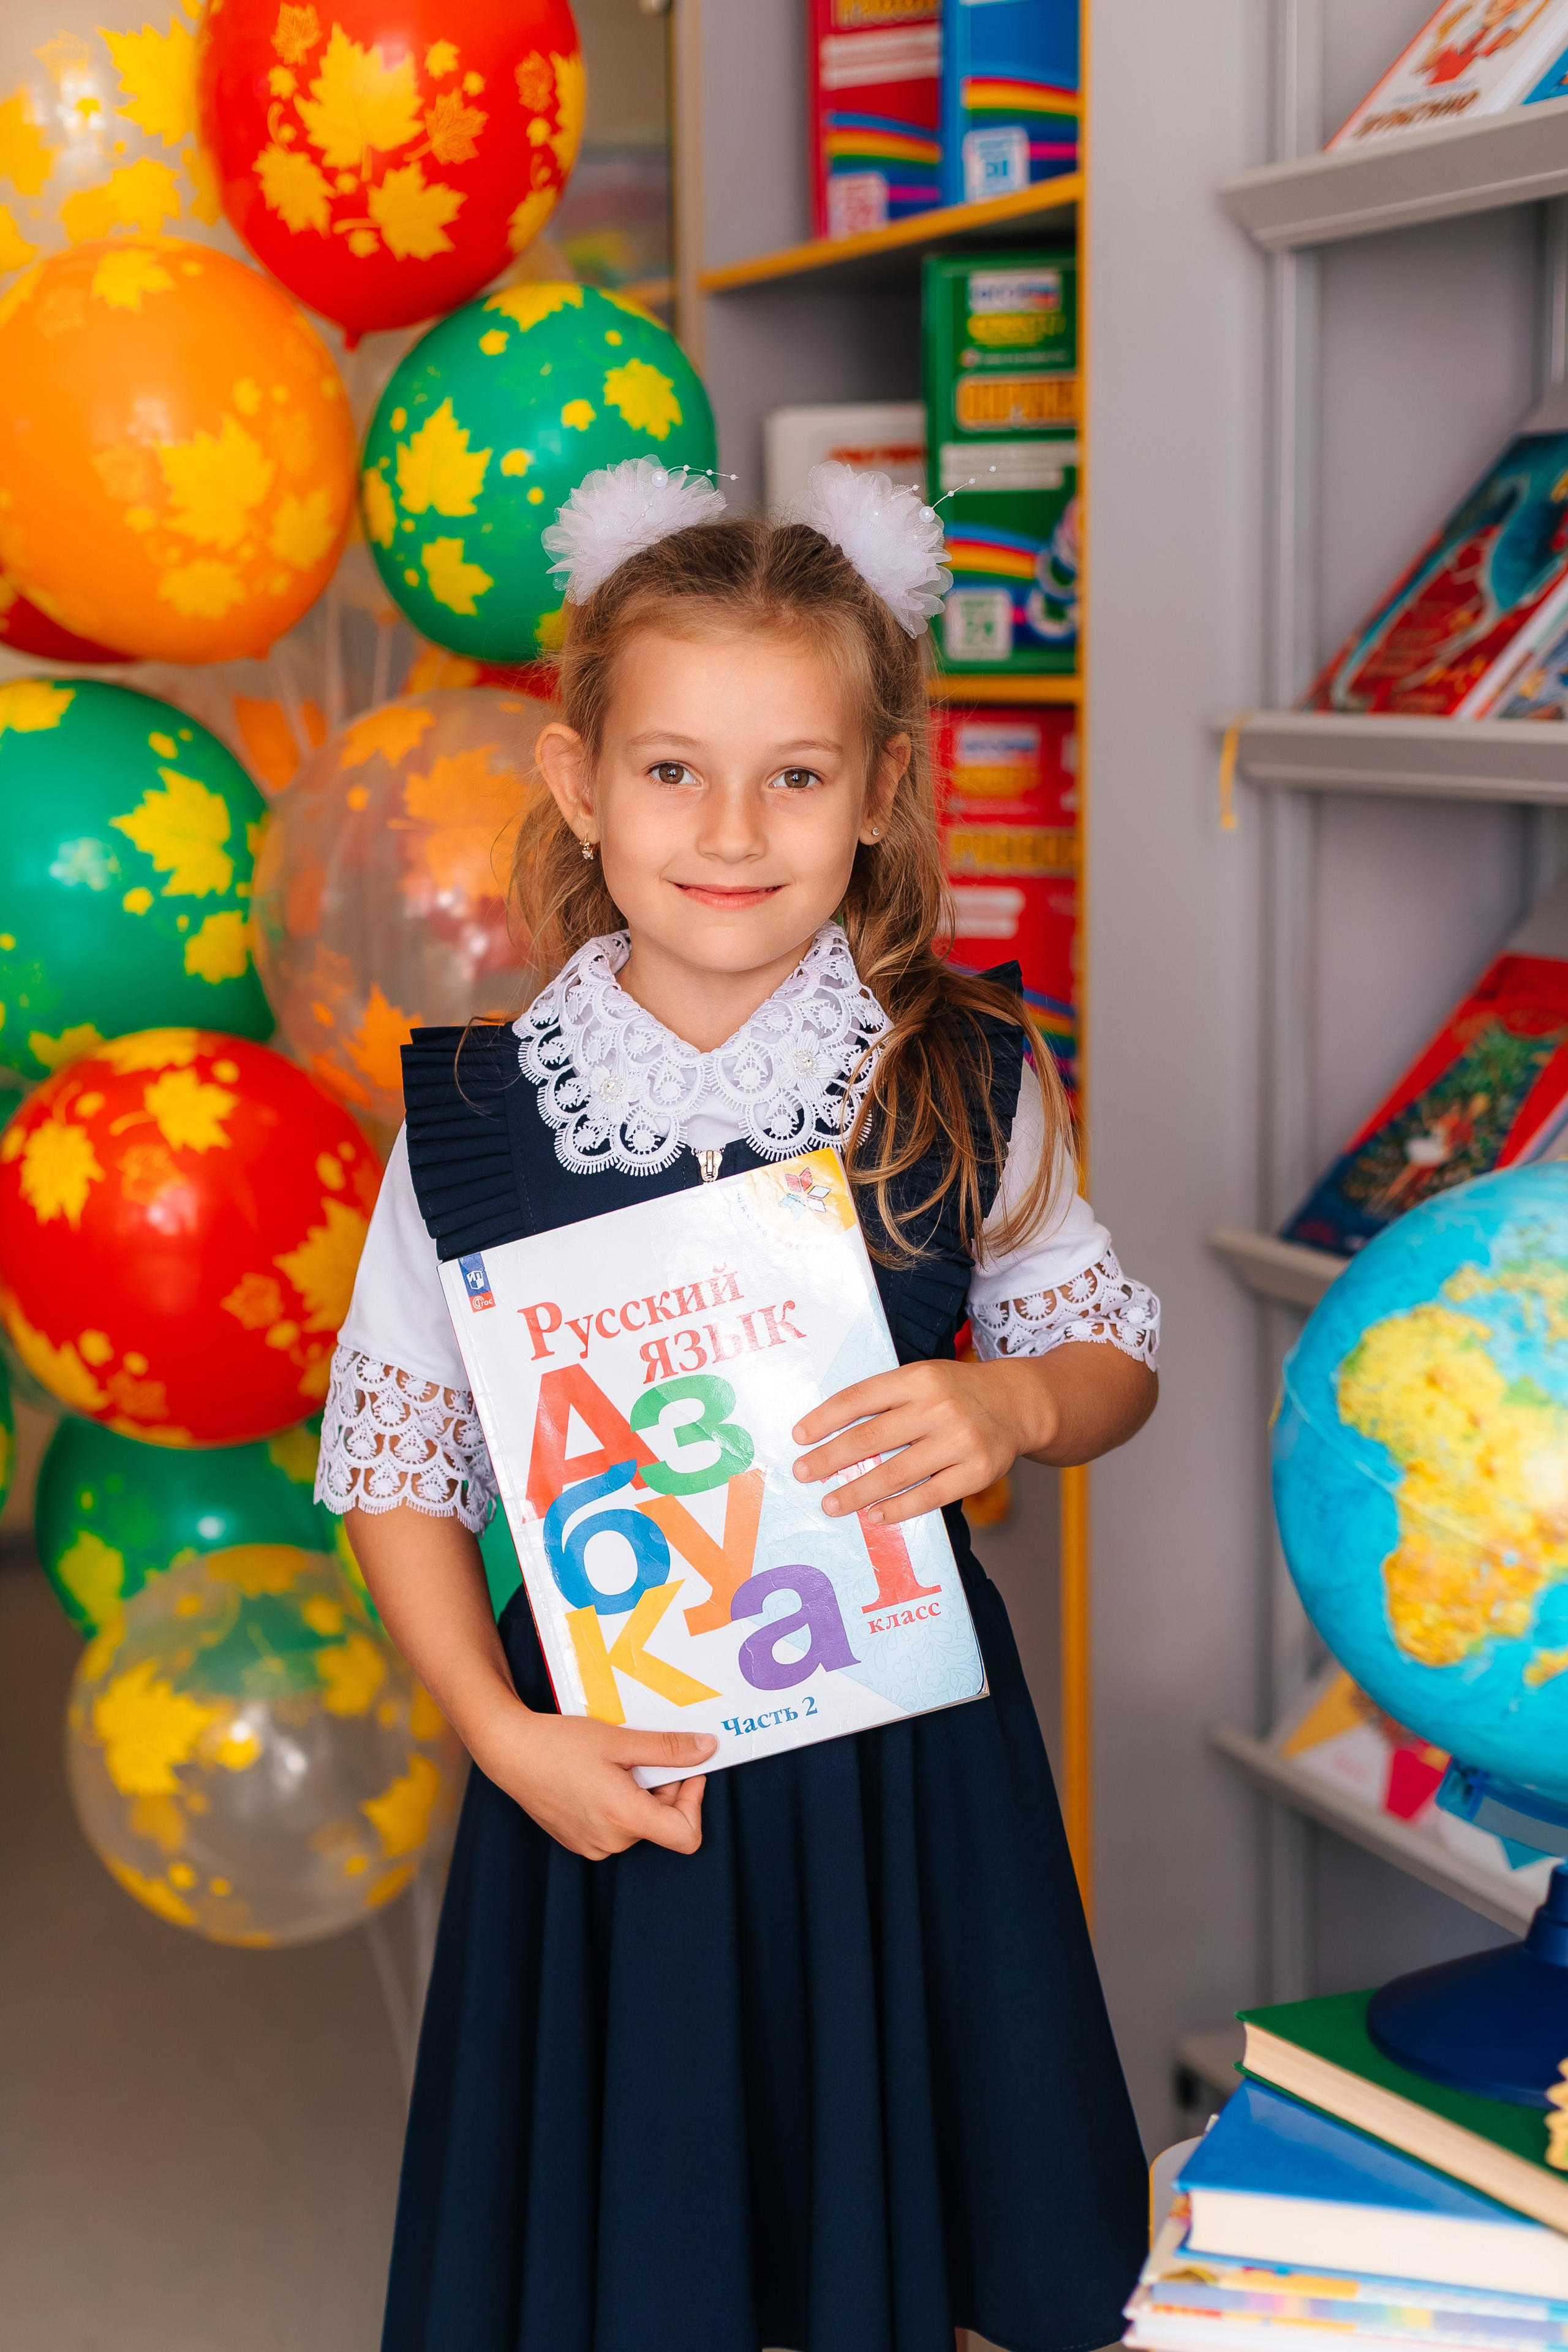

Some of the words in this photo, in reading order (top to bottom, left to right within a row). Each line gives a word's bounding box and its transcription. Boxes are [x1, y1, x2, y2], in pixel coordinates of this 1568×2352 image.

[517, 1262, 745, 1361] Русский
[867, 1602, 942, 1635] класс
[721, 1707, 799, 1736] Часть
[802, 1696, 818, 1716] 2
